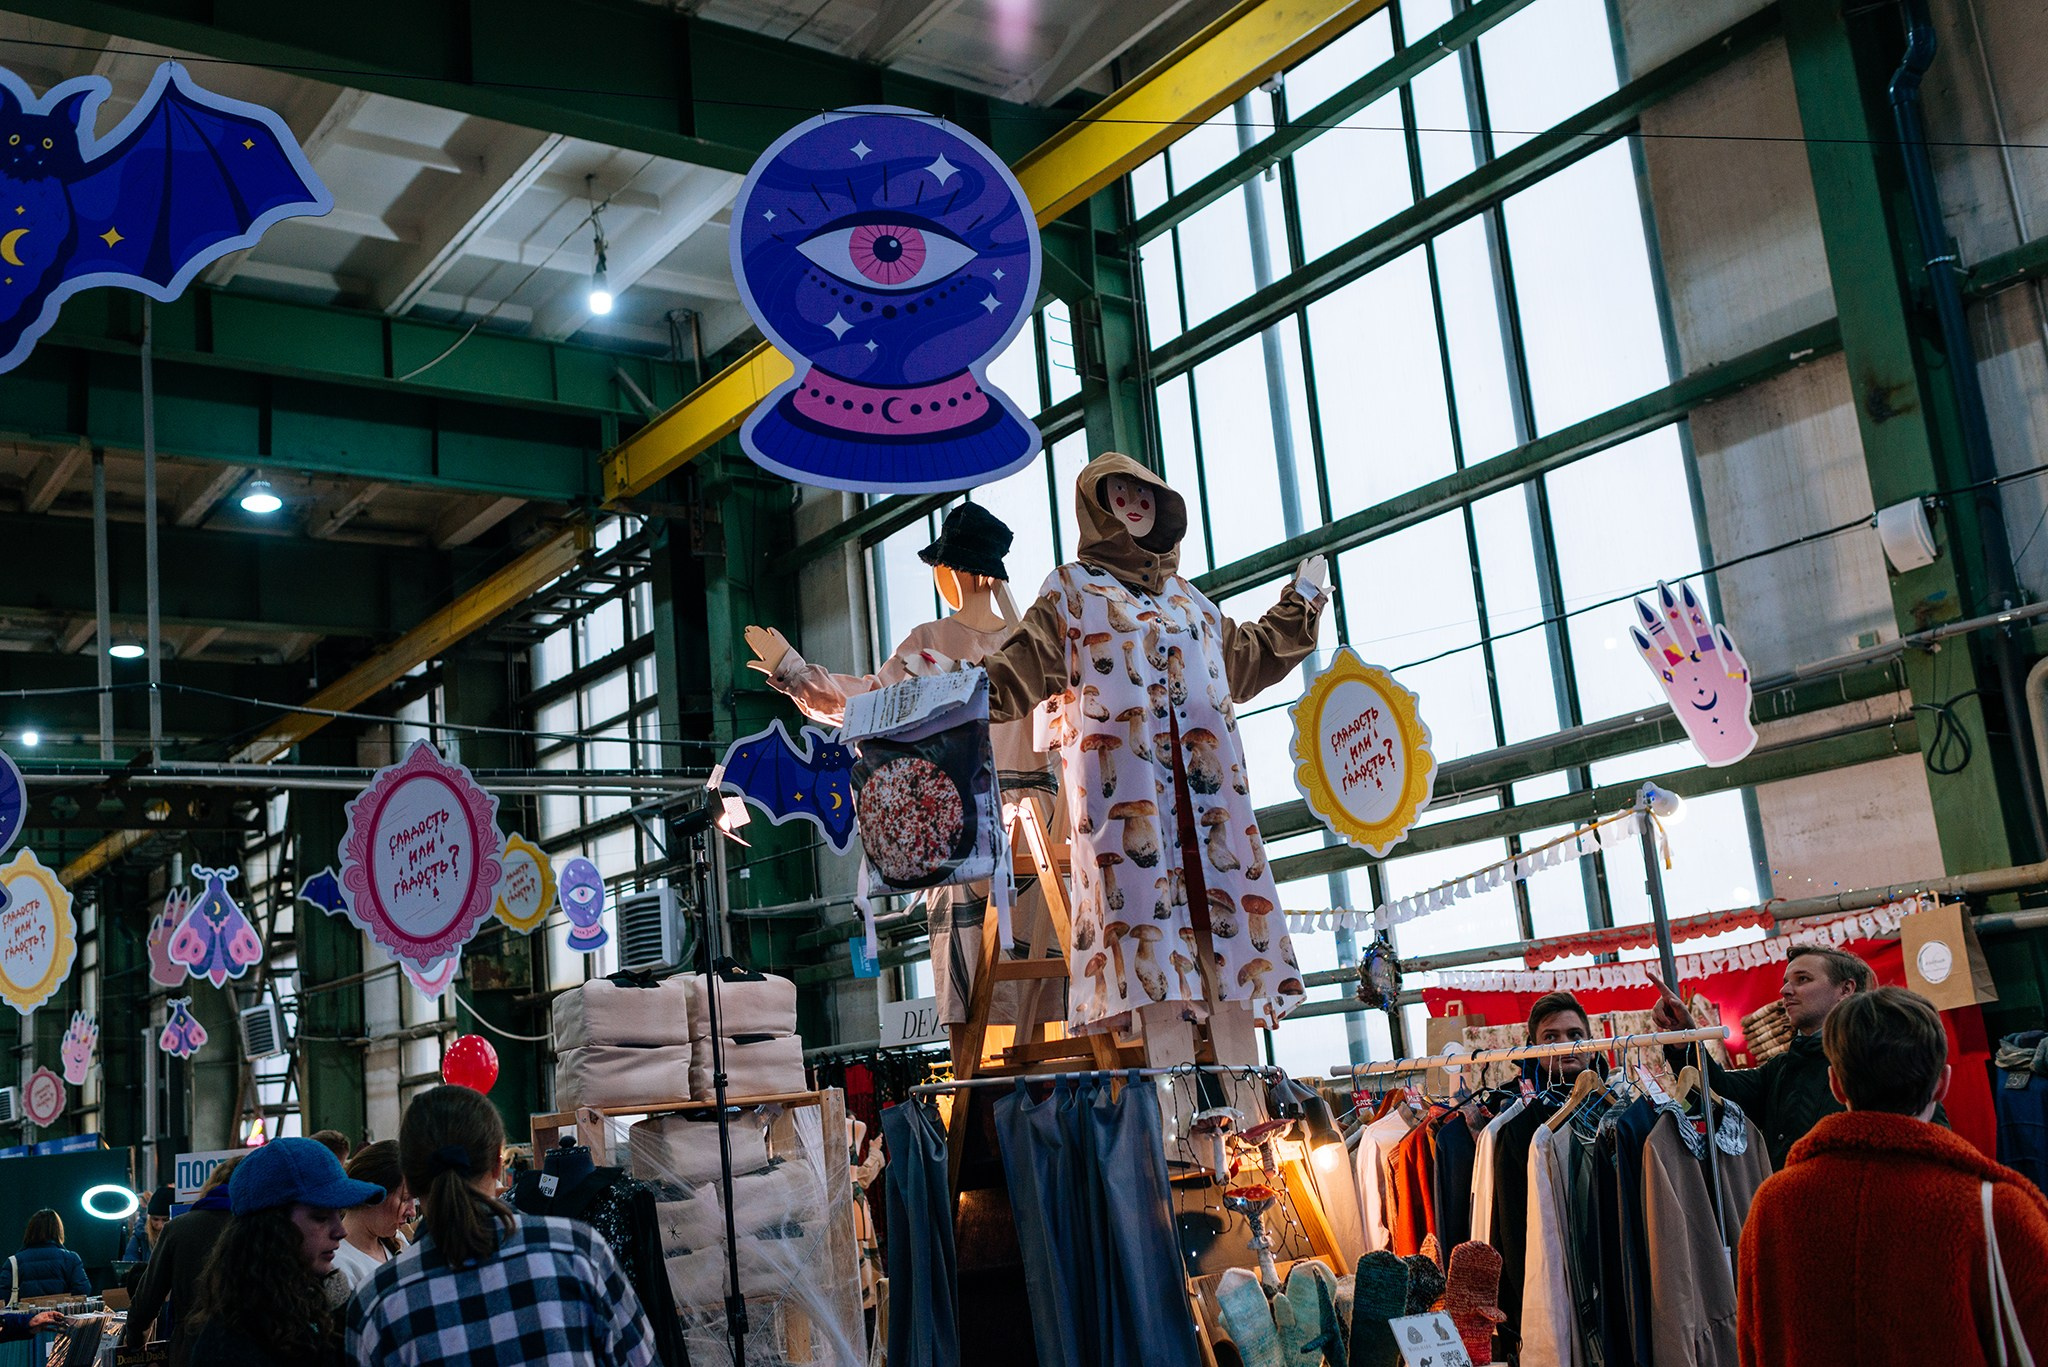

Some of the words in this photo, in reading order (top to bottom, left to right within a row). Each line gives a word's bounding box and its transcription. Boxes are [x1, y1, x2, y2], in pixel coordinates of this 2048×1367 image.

[1331, 707, 1378, 756] СЛАДОСТЬ
[1349, 733, 1372, 766] ИЛИ
[389, 808, 449, 858] СЛАДОСТЬ
[409, 837, 435, 871] ИЛИ
[2, 899, 40, 933] СЛАДОСТЬ
[14, 919, 31, 941] ИЛИ
